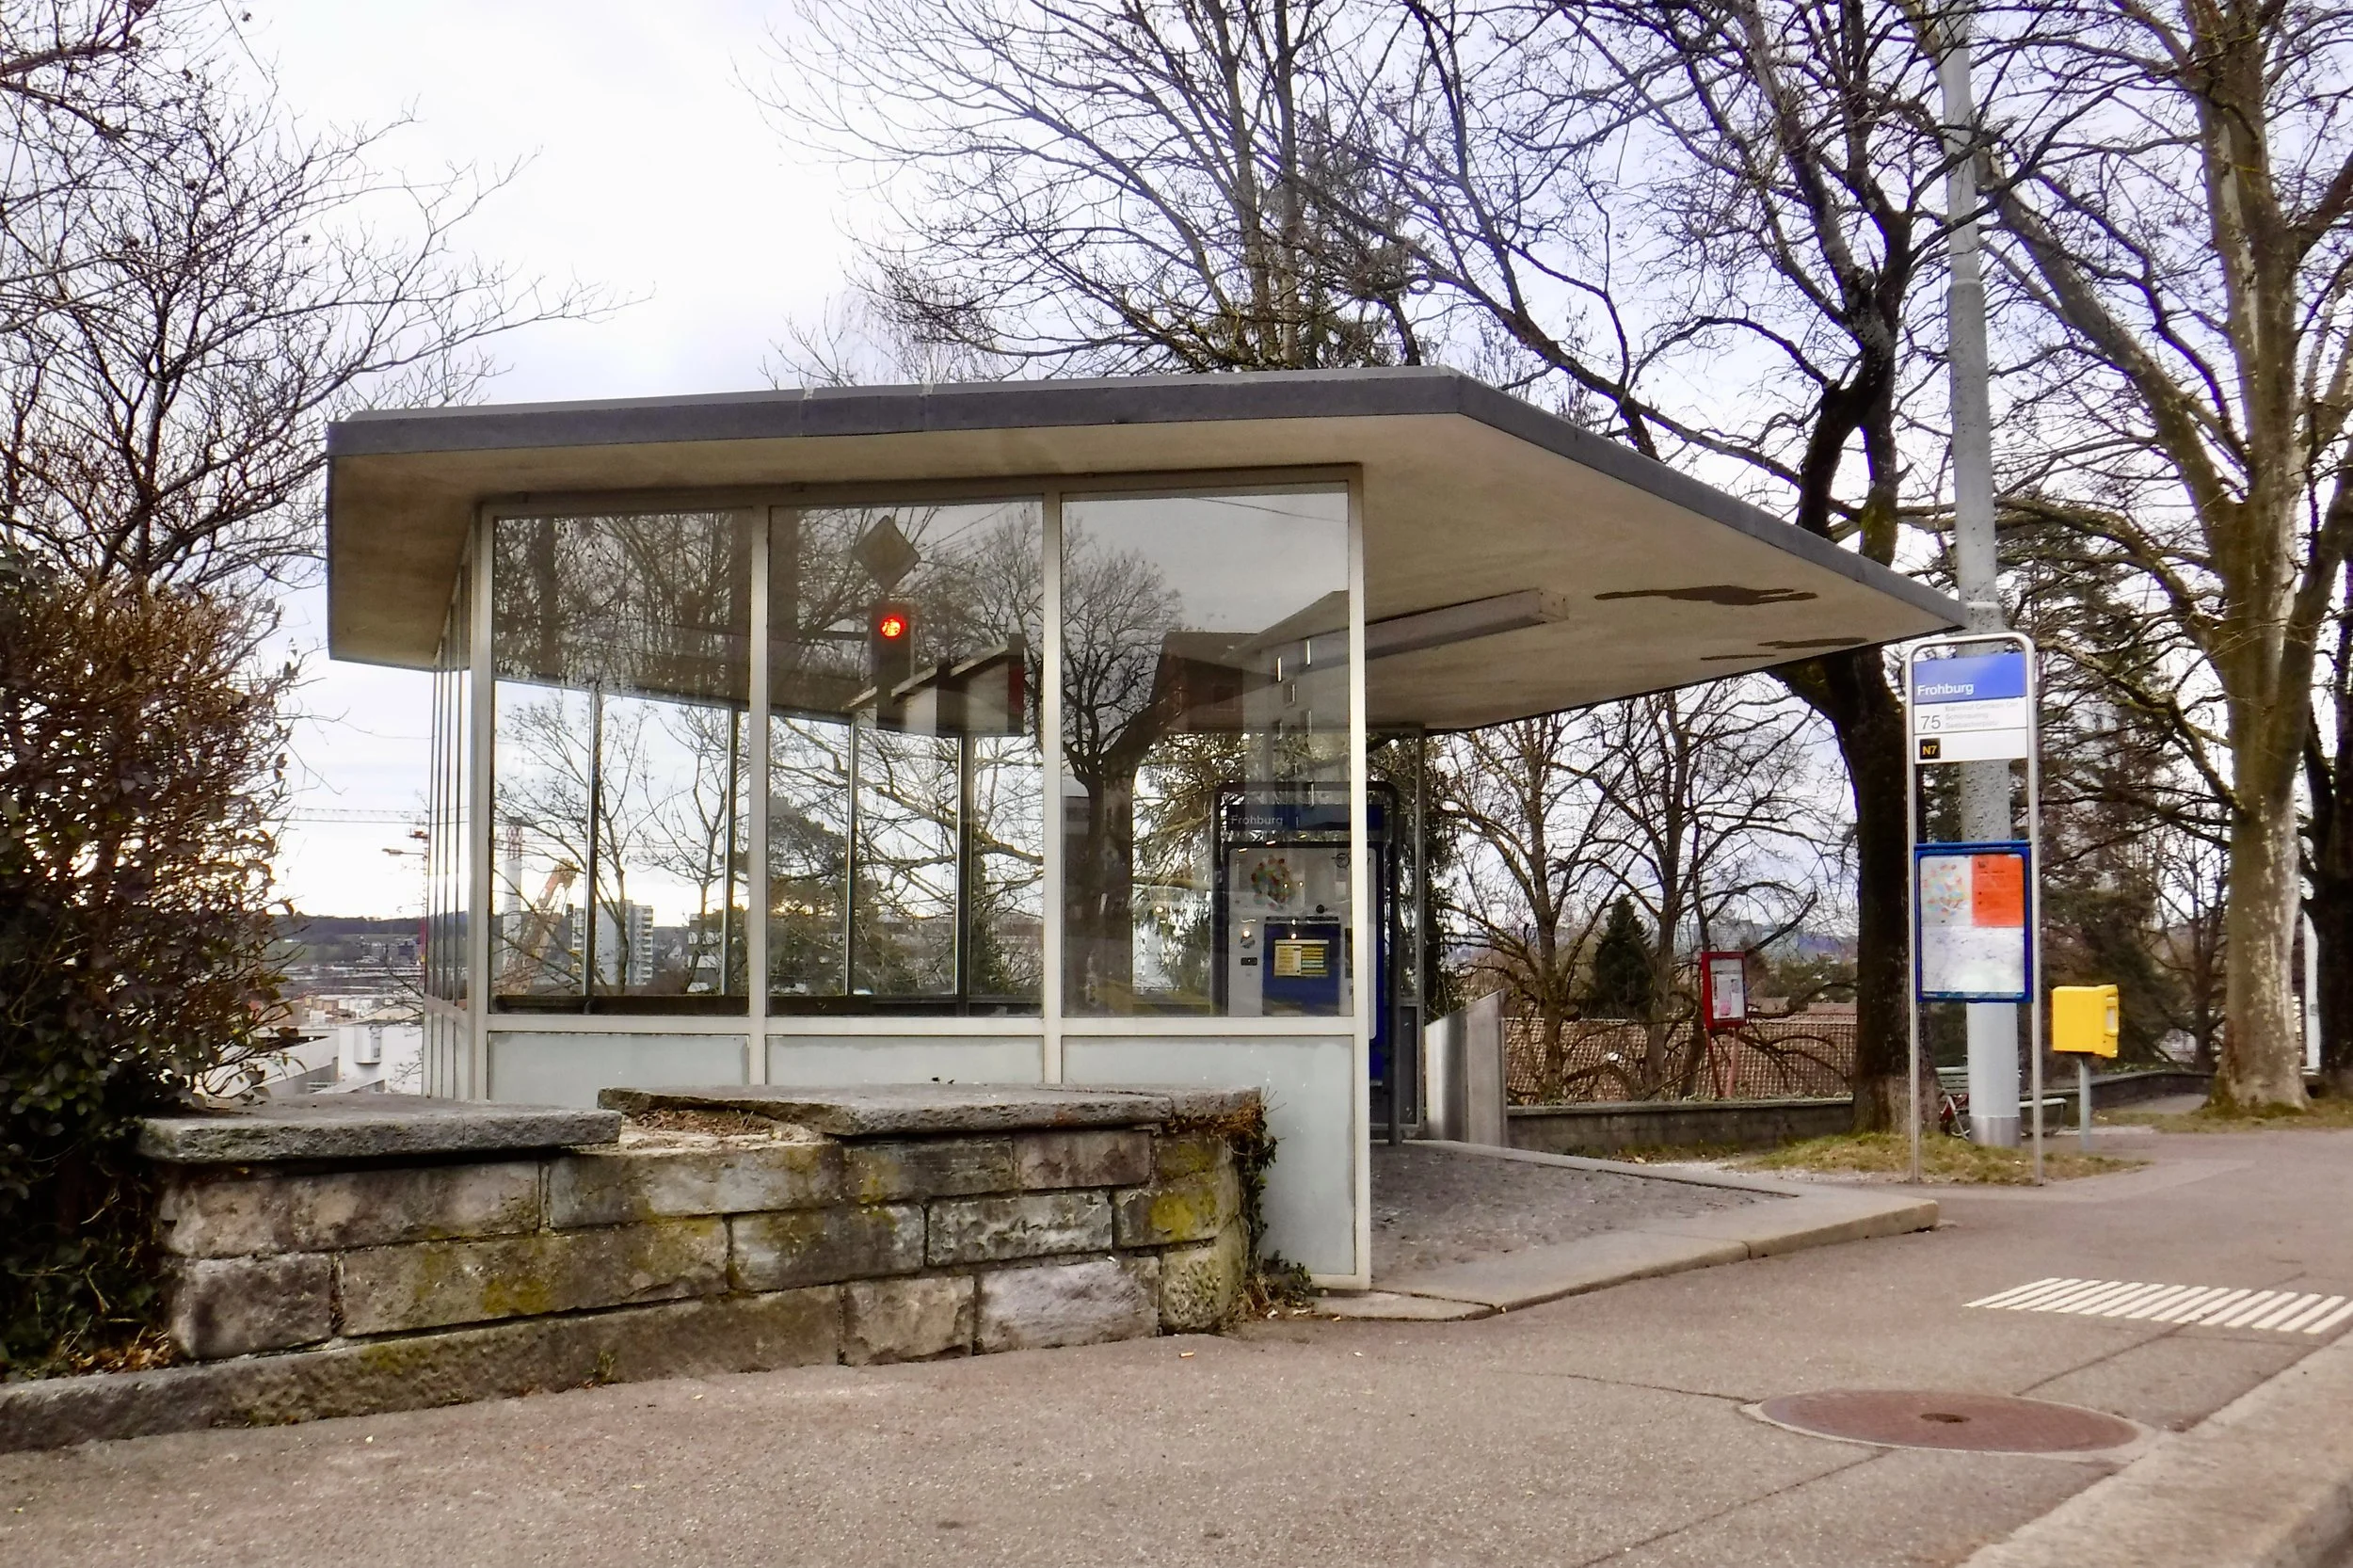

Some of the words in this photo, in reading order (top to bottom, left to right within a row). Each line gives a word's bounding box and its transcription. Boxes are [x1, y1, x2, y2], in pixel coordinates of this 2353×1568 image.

[1917, 683, 1974, 696] Frohburg
[1921, 715, 1941, 729] 75
[1922, 745, 1937, 755] N7
[1231, 814, 1283, 825] Frohburg
